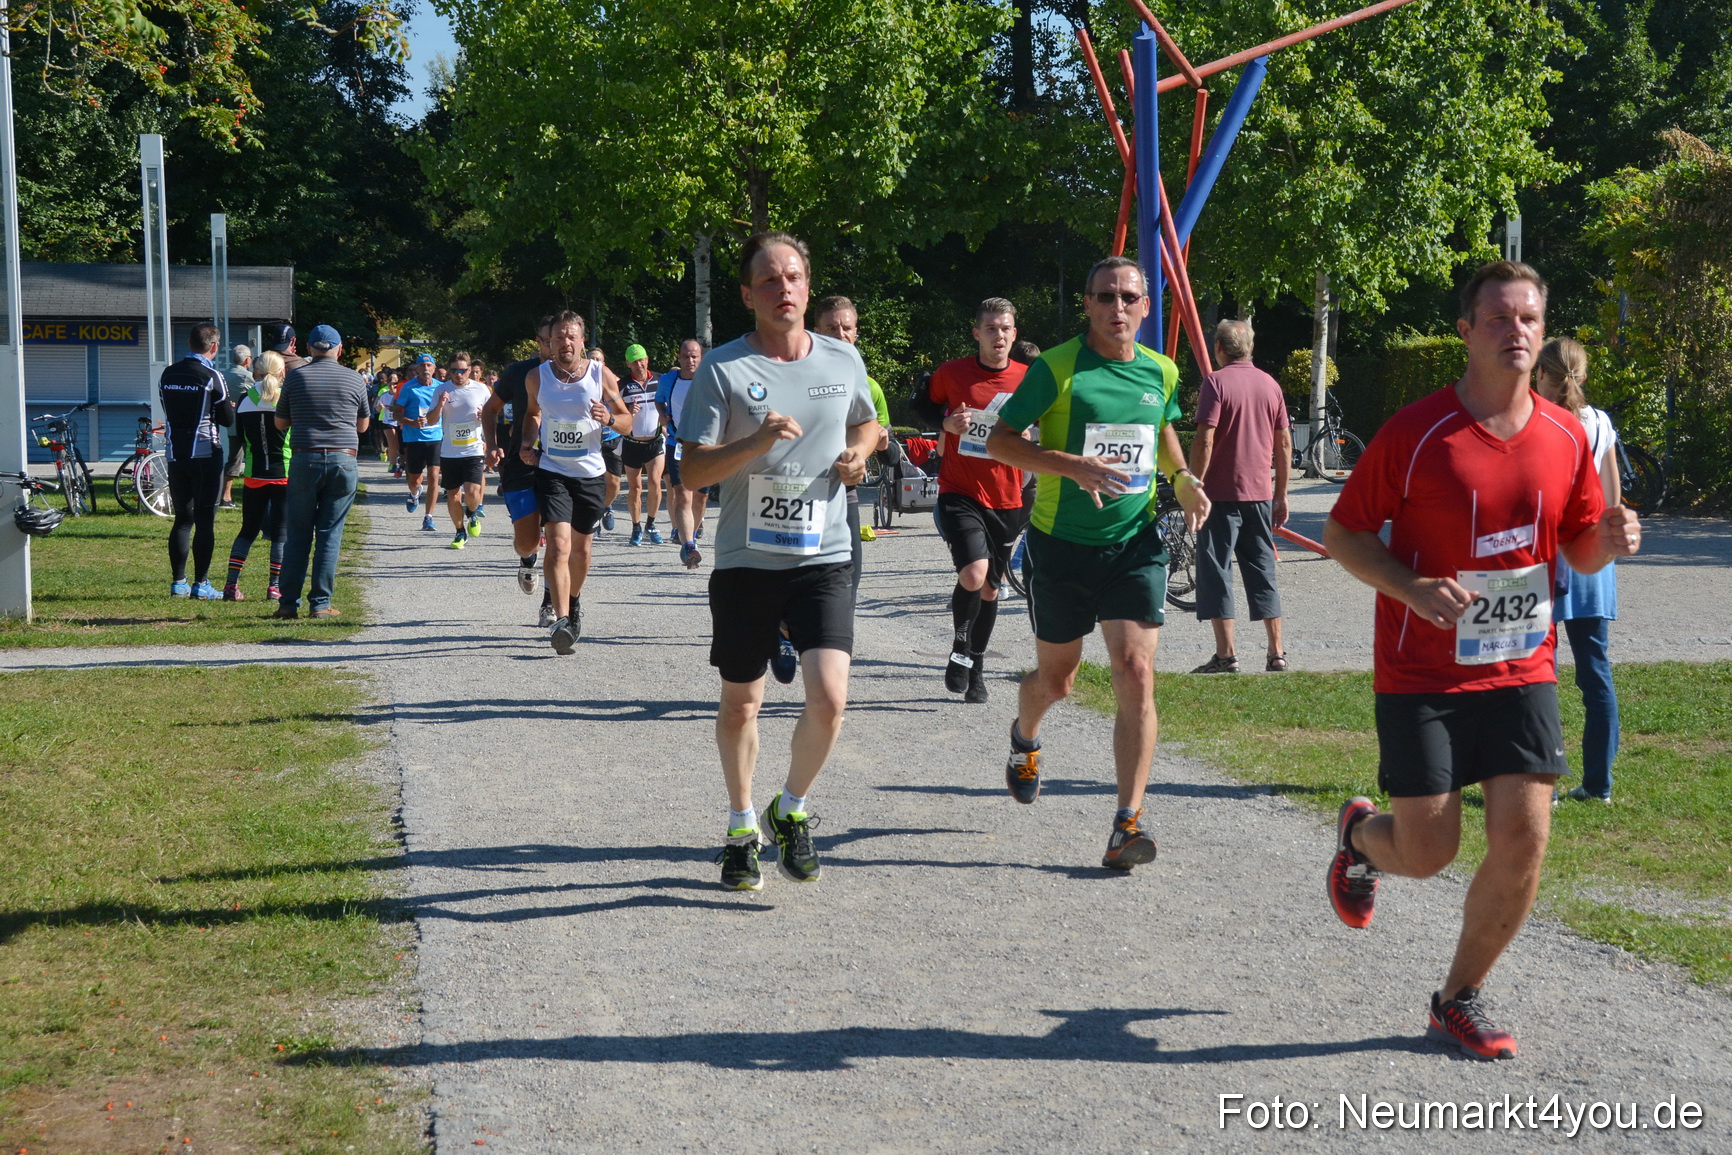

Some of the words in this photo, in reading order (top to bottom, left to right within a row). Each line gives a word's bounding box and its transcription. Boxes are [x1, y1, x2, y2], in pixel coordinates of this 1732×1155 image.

[22, 324, 67, 339] CAFE
[79, 325, 134, 340] KIOSK
[808, 384, 846, 397] BOCK
[456, 428, 471, 438] 329
[553, 431, 583, 444] 3092
[1105, 429, 1135, 438] BOCK
[1094, 443, 1144, 464] 2567
[783, 461, 805, 477] 19.
[773, 482, 808, 492] BOCK
[760, 496, 814, 521] 2521
[775, 533, 799, 545] Sven
[1492, 535, 1518, 549] DEHN
[1488, 577, 1527, 589] BOCK
[1472, 592, 1538, 625] 2432
[1481, 639, 1517, 652] MARCUS
